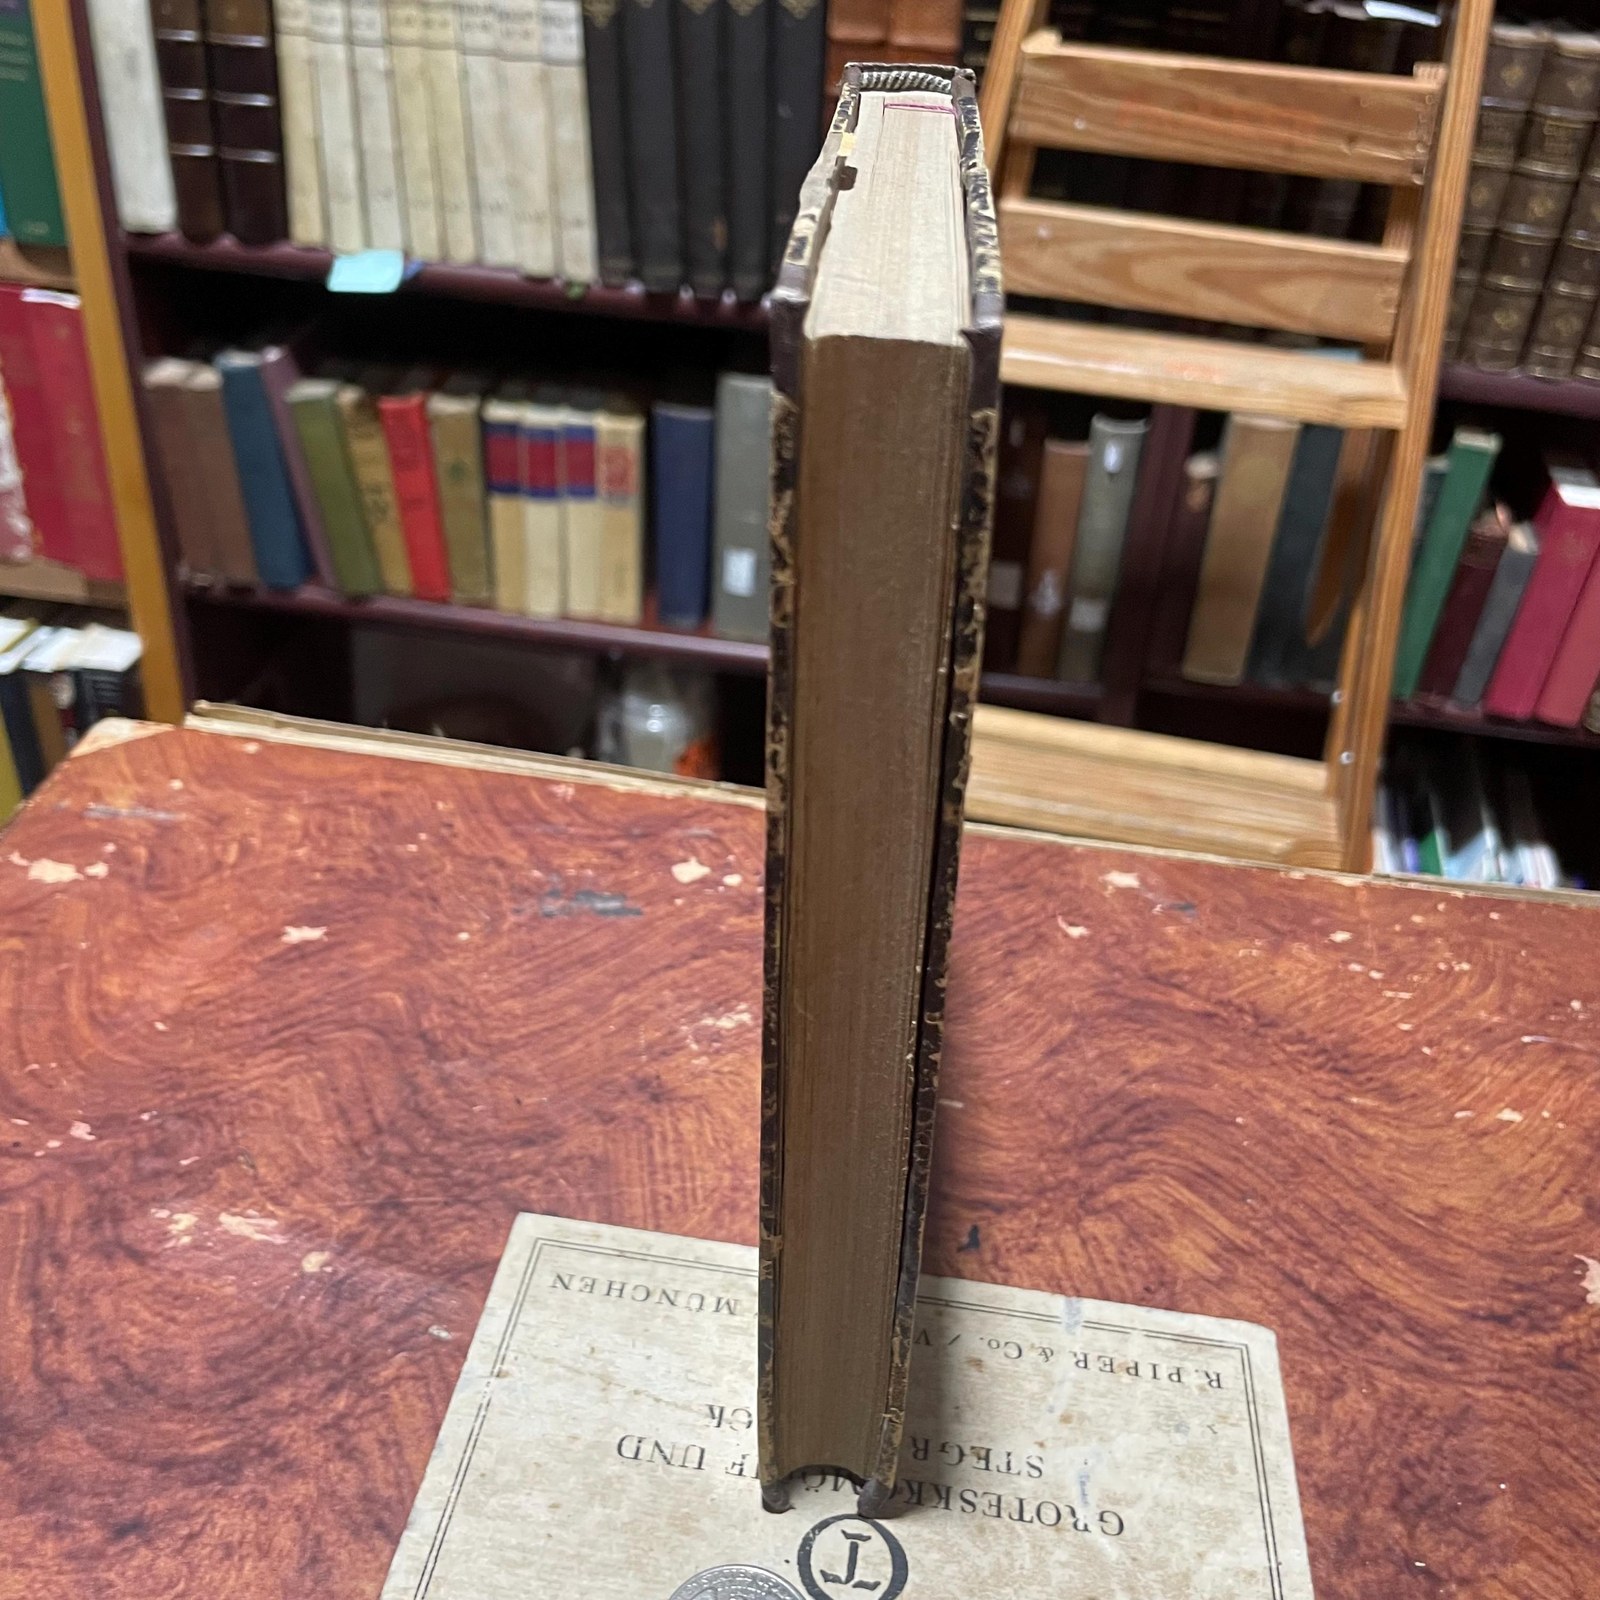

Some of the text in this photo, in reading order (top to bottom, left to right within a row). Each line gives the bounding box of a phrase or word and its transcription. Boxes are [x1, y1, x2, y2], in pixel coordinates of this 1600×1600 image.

[548, 1270, 740, 1316] MÜNCHEN
[980, 1335, 1024, 1361] Co.
[1034, 1344, 1055, 1363] &
[1072, 1351, 1186, 1385] PIPER
[1194, 1368, 1224, 1390] R.
[616, 1433, 707, 1472] UND
